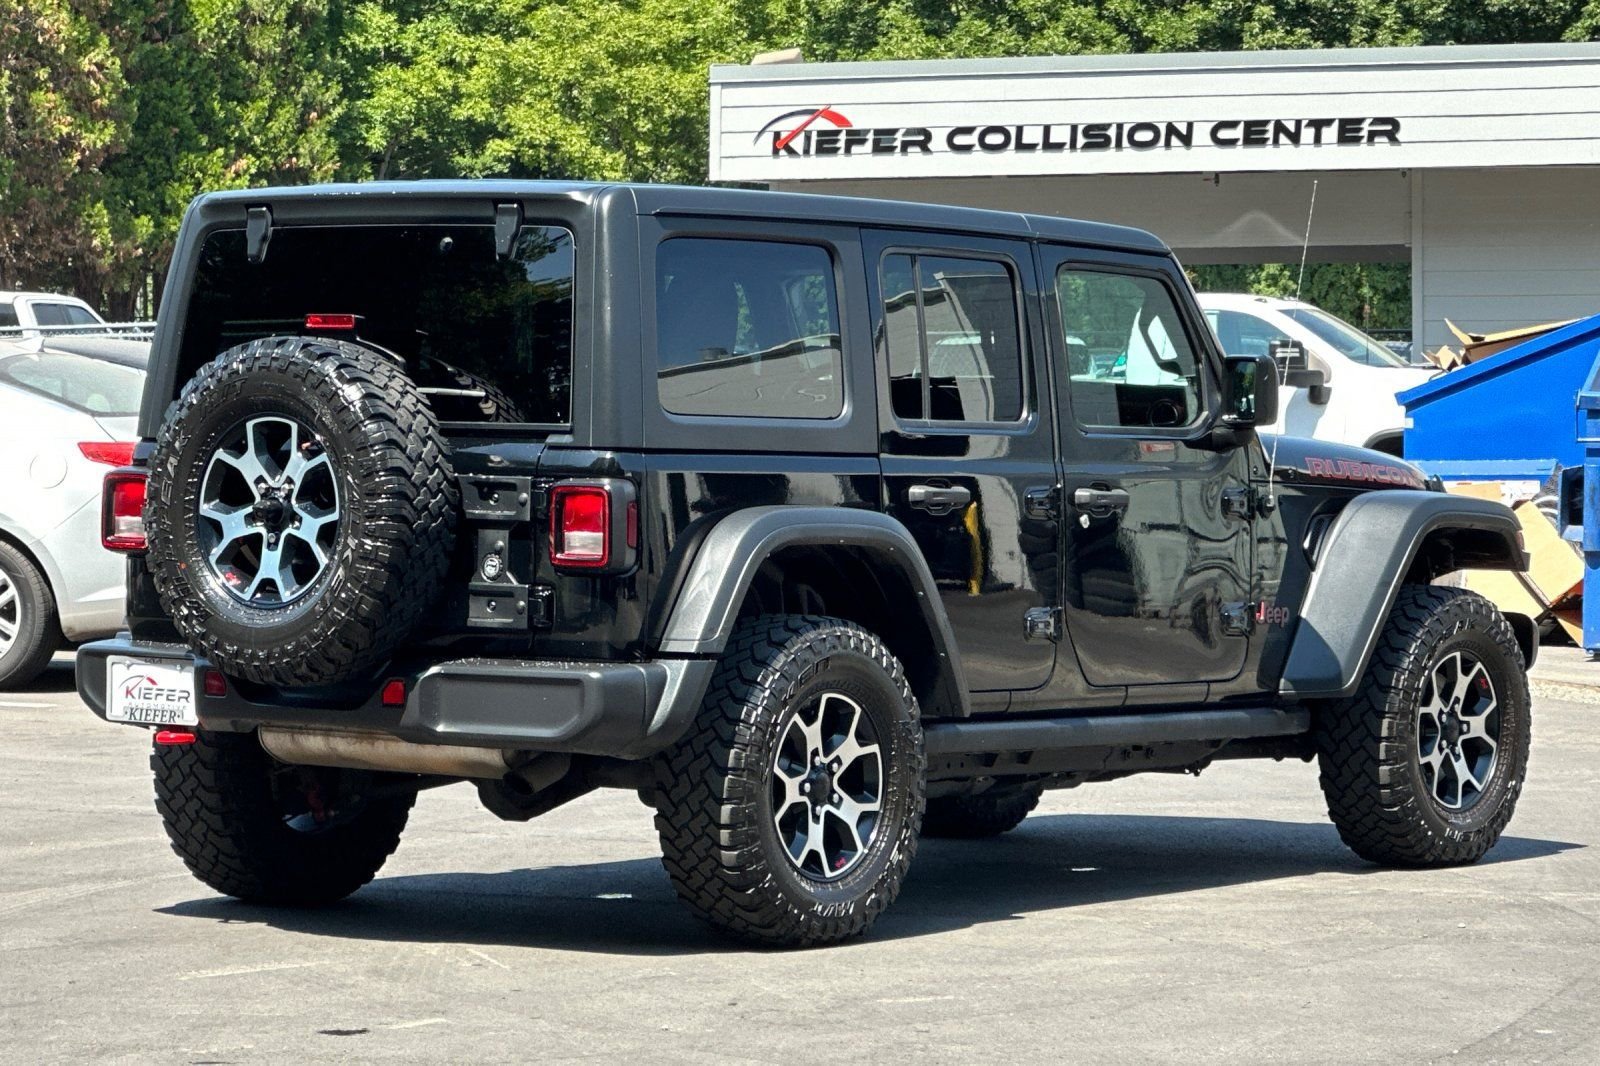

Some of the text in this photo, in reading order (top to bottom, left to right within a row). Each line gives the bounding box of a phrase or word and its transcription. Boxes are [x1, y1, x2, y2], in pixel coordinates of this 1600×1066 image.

[772, 116, 1401, 158] KIEFER COLLISION CENTER
[1305, 457, 1426, 489] RUBICON
[1255, 601, 1290, 628] Jeep
[124, 685, 191, 703] KIEFER
[128, 707, 177, 723] KIEFER
